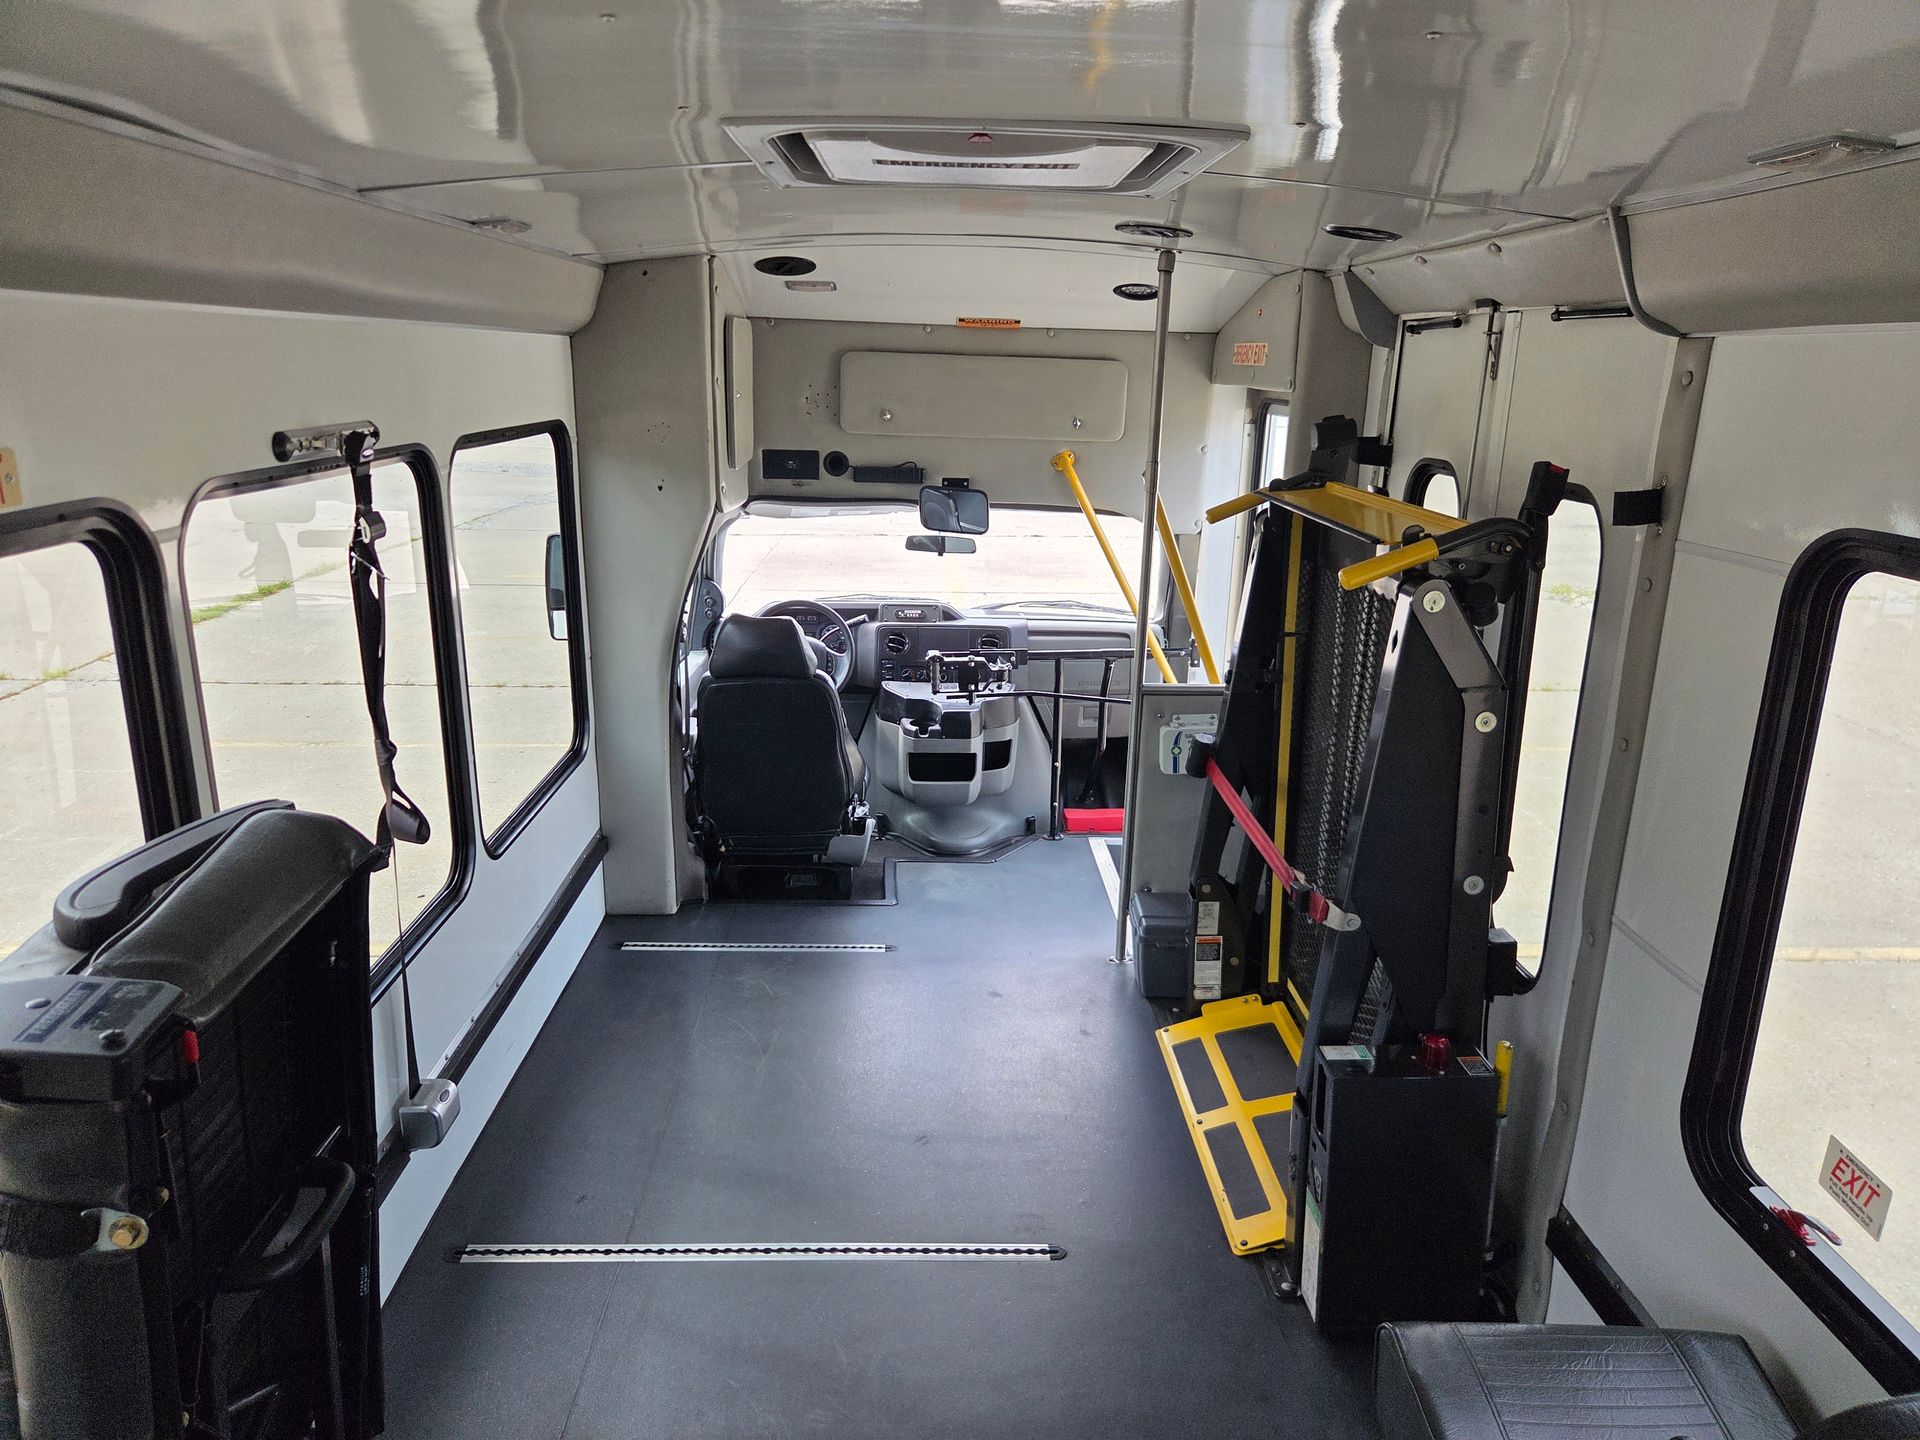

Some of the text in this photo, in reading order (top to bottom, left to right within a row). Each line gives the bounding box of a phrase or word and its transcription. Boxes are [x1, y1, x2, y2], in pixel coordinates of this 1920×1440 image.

[876, 159, 1016, 169] EMERGENCY
[1845, 1154, 1873, 1181] EMERGENCY
[1830, 1157, 1881, 1208] EXIT
[1841, 1198, 1860, 1218] Window
[1848, 1195, 1866, 1215] Handle
